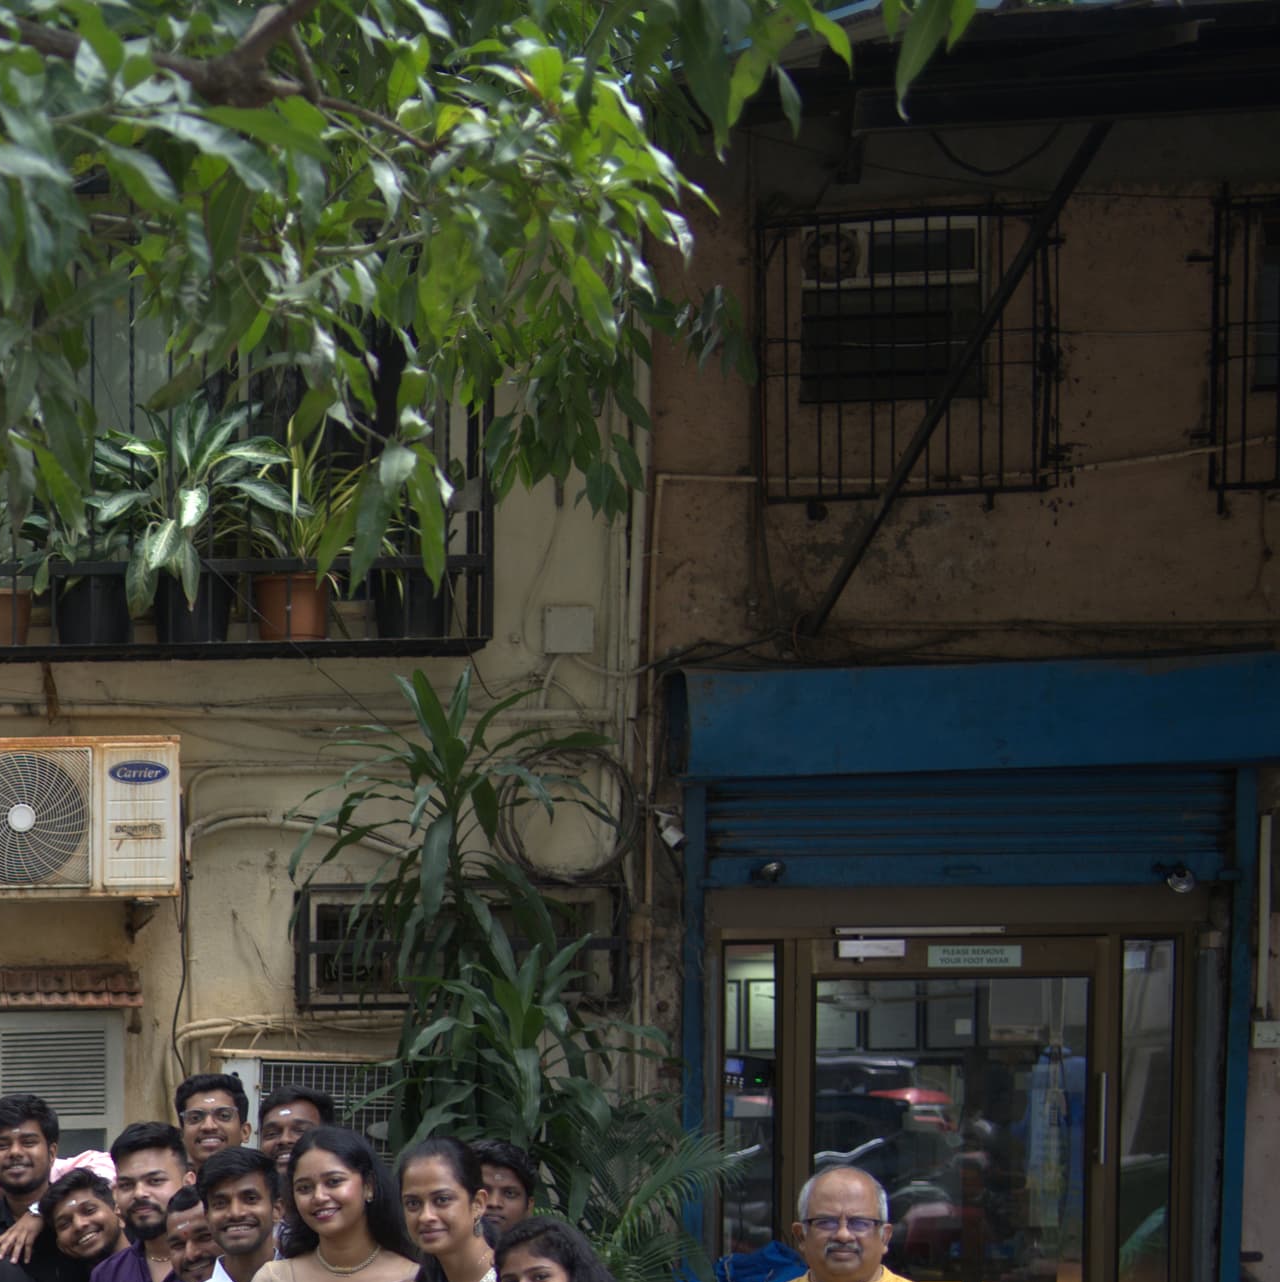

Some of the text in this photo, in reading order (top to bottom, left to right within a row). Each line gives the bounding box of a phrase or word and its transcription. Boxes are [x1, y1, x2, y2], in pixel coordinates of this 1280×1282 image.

[116, 767, 162, 779] Carrier
[942, 948, 1005, 956] PLEASE REMOVE
[940, 957, 1009, 965] YOUR FOOT WEAR
